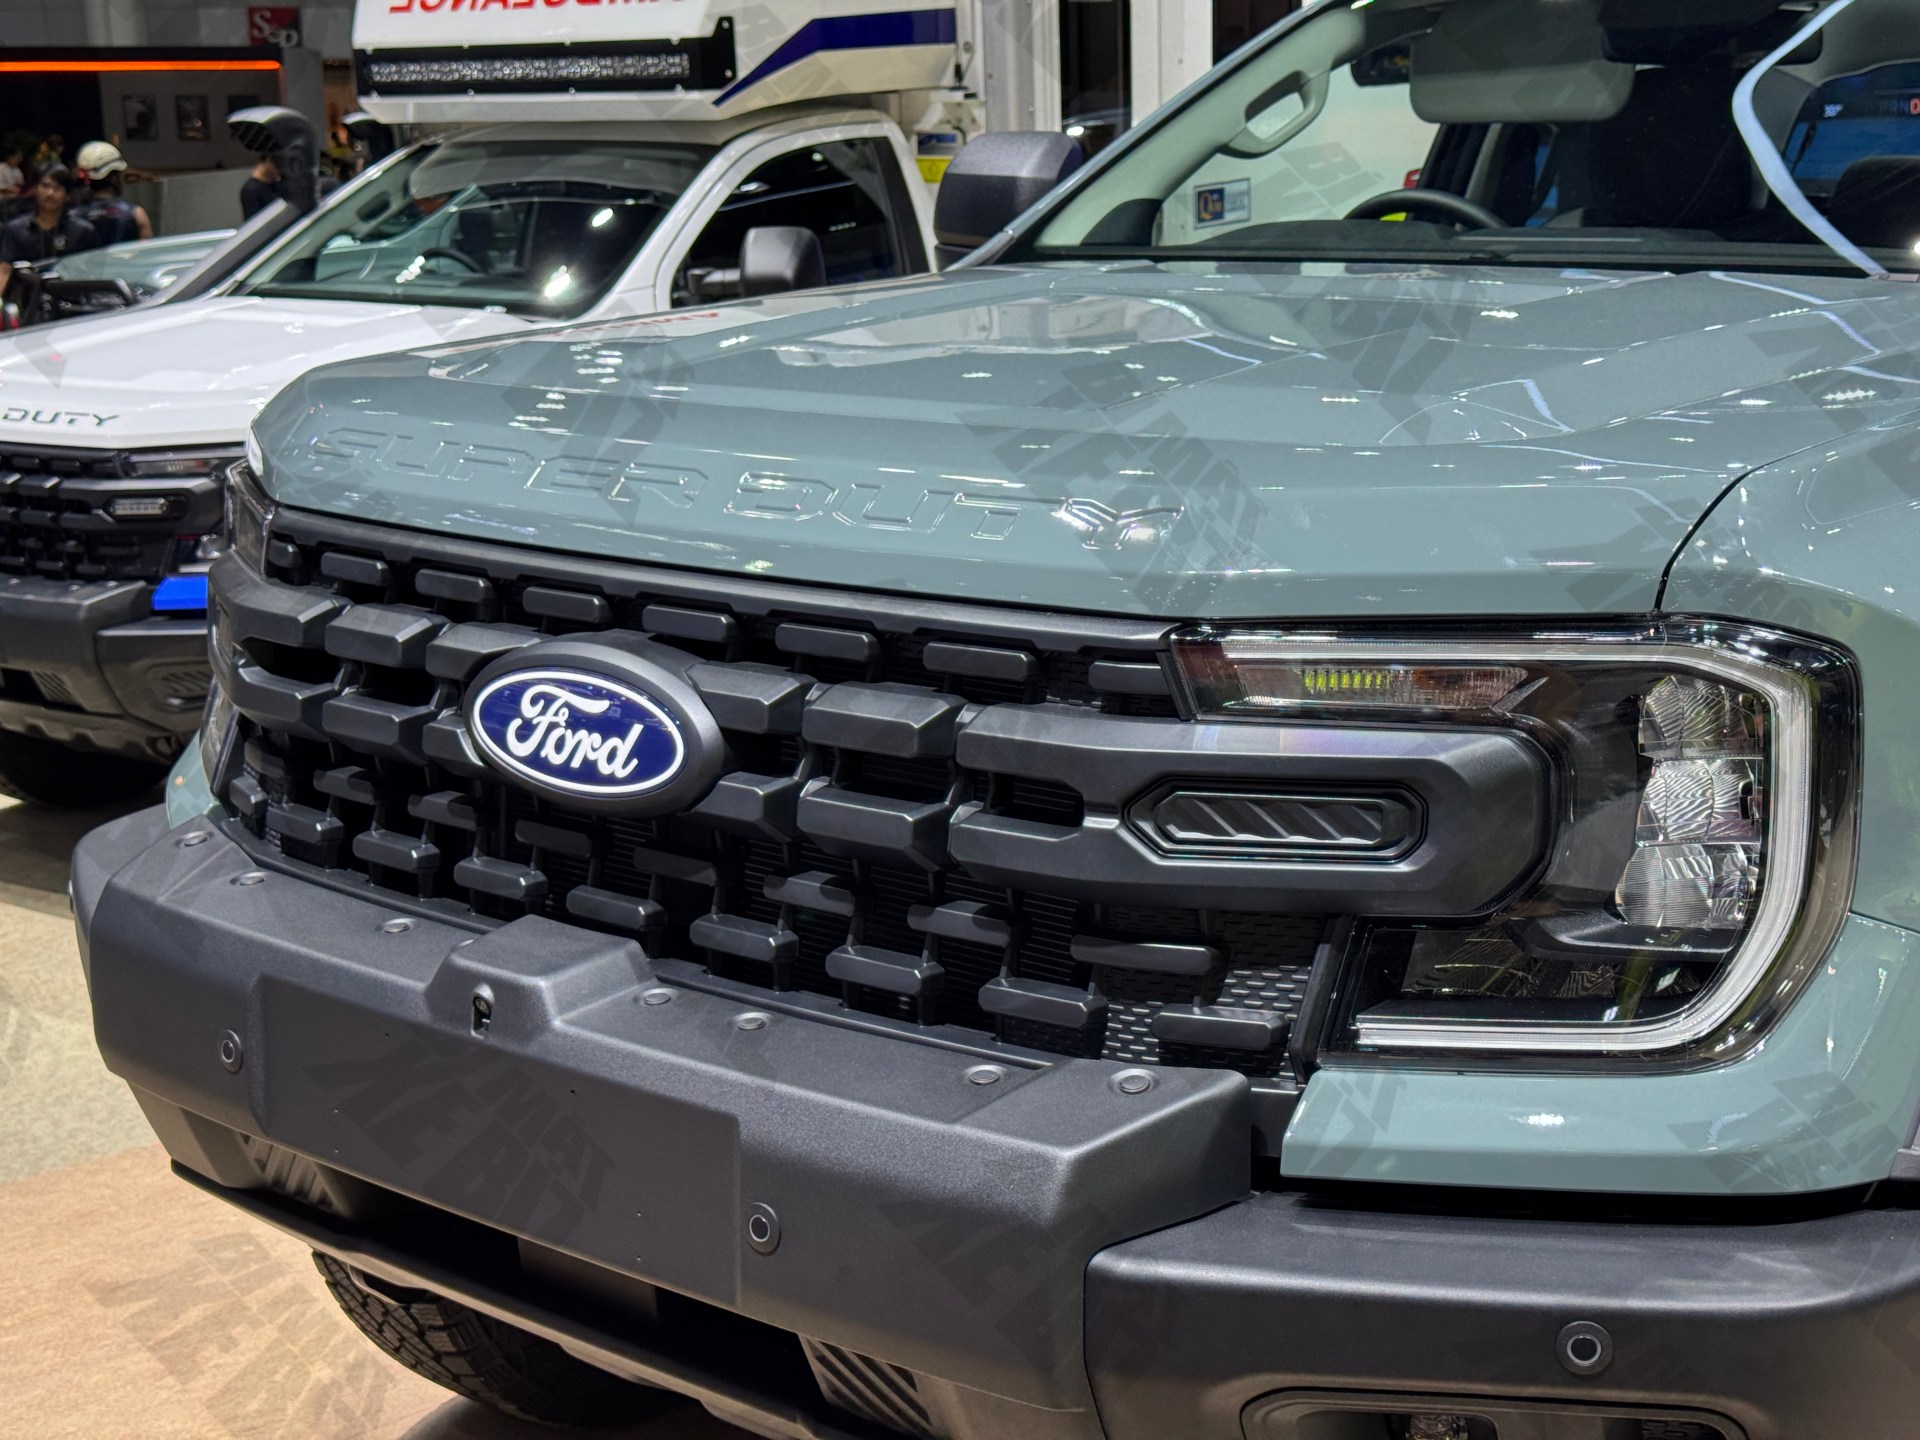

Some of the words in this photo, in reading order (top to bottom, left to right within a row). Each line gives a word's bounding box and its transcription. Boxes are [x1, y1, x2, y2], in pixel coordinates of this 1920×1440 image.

[2, 406, 121, 427] DUTY
[307, 427, 709, 509] SUPER
[723, 471, 1185, 550] DUTY
[506, 684, 645, 779] Ford
